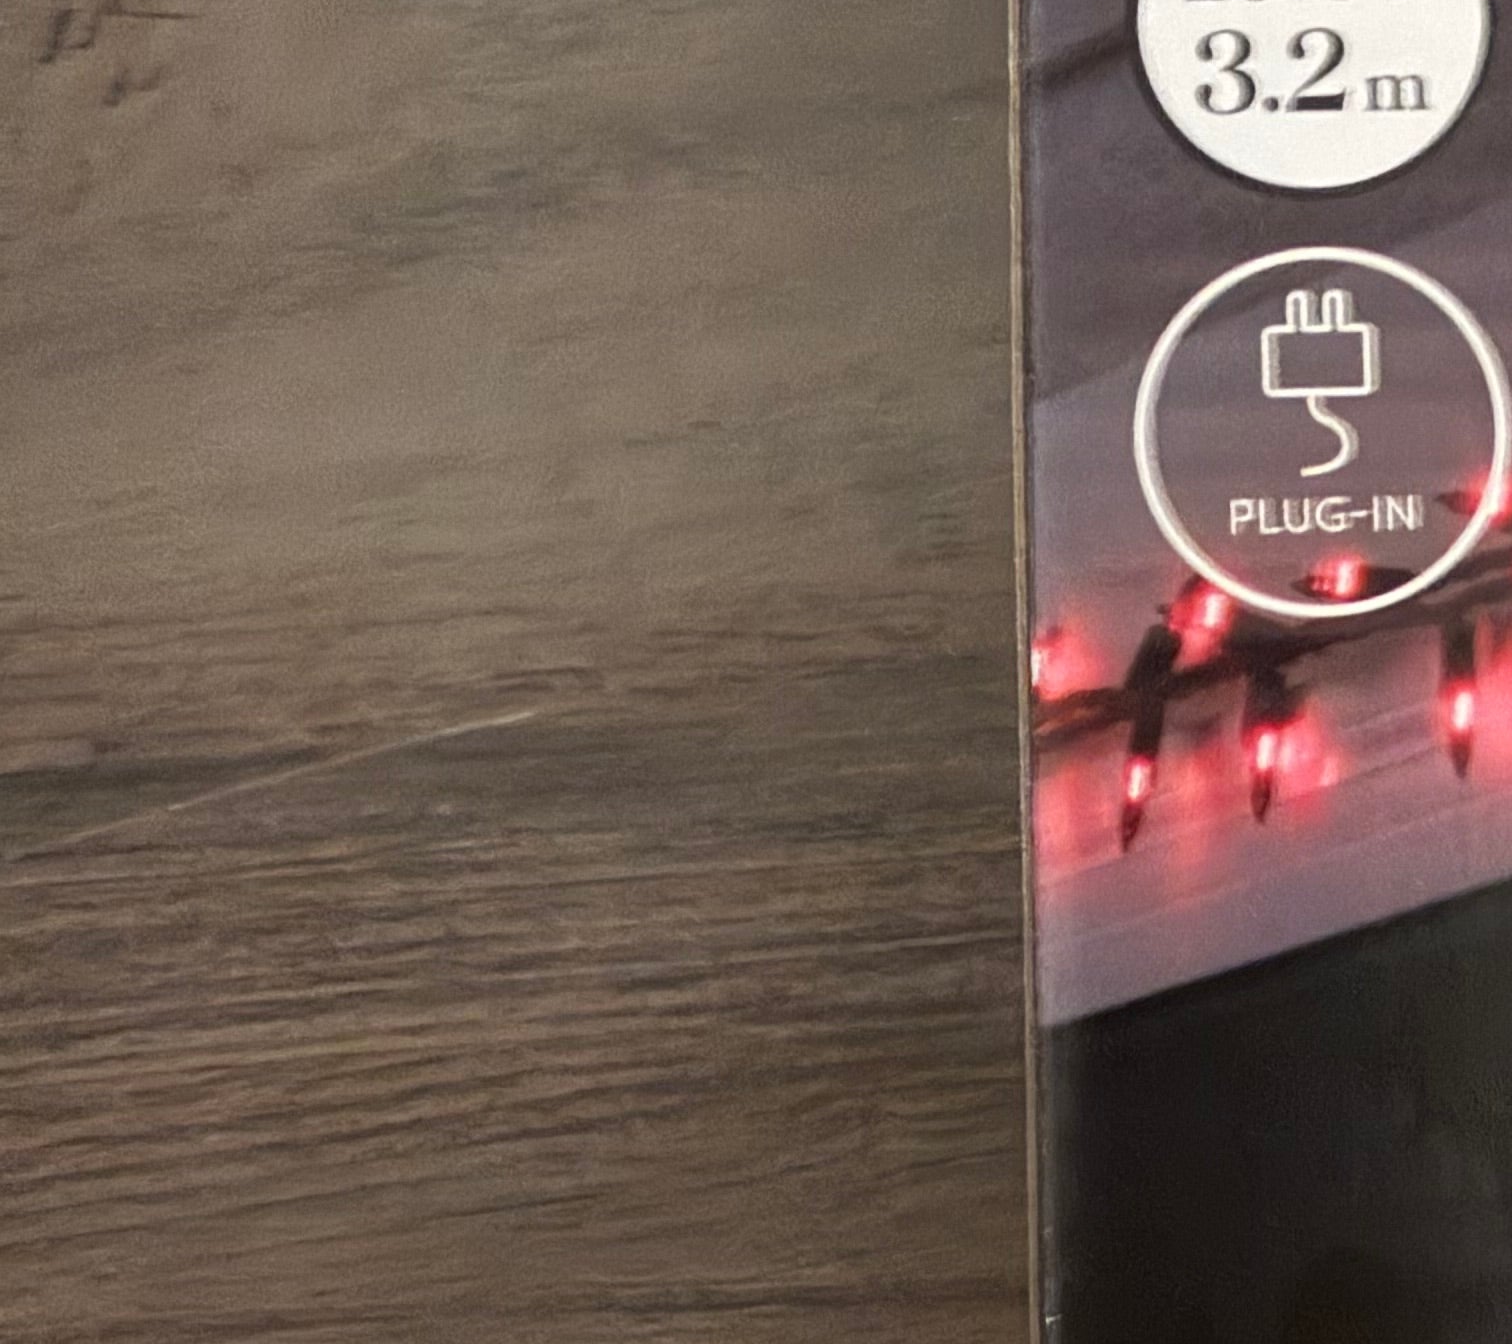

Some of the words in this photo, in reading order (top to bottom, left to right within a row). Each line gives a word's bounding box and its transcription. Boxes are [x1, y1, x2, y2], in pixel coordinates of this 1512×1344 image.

[1195, 28, 1349, 116] 3.2
[1363, 69, 1434, 113] m
[1229, 493, 1426, 536] PLUG-IN
